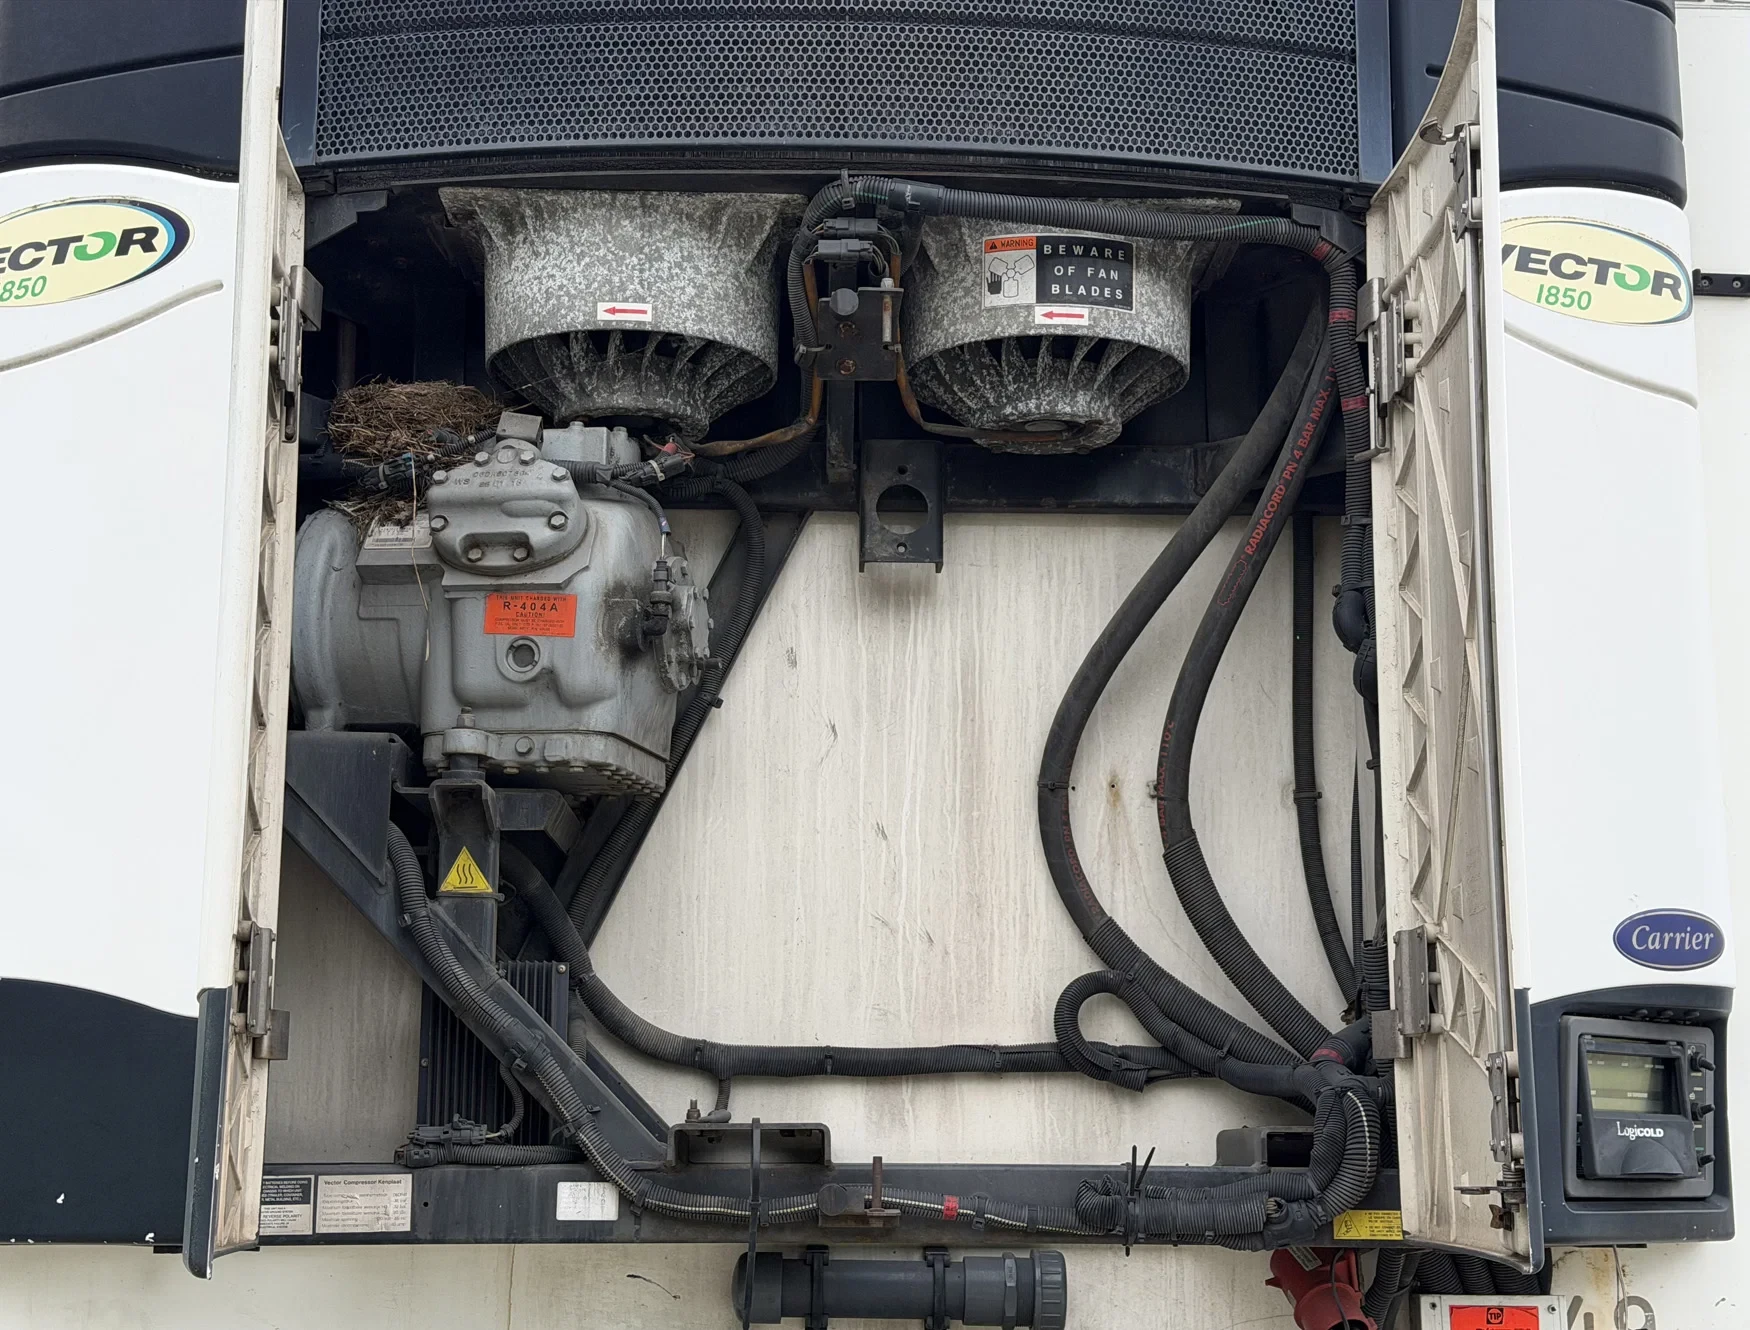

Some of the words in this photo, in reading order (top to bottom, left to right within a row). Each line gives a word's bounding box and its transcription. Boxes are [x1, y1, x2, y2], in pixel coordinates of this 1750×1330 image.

[1000, 238, 1034, 248] WARNING
[1043, 244, 1125, 260] BEWARE
[1054, 265, 1076, 276] OF
[1087, 267, 1119, 280] FAN
[0, 275, 47, 302] 850
[1051, 284, 1123, 299] BLADES
[1536, 283, 1592, 310] 1850
[1310, 387, 1332, 421] MAX.
[1297, 422, 1317, 448] BAR
[1293, 449, 1304, 460] 4
[1282, 461, 1298, 481] PN
[503, 601, 558, 612] R-404A
[1631, 925, 1714, 950] Carrier
[1488, 1312, 1502, 1320] TIP
